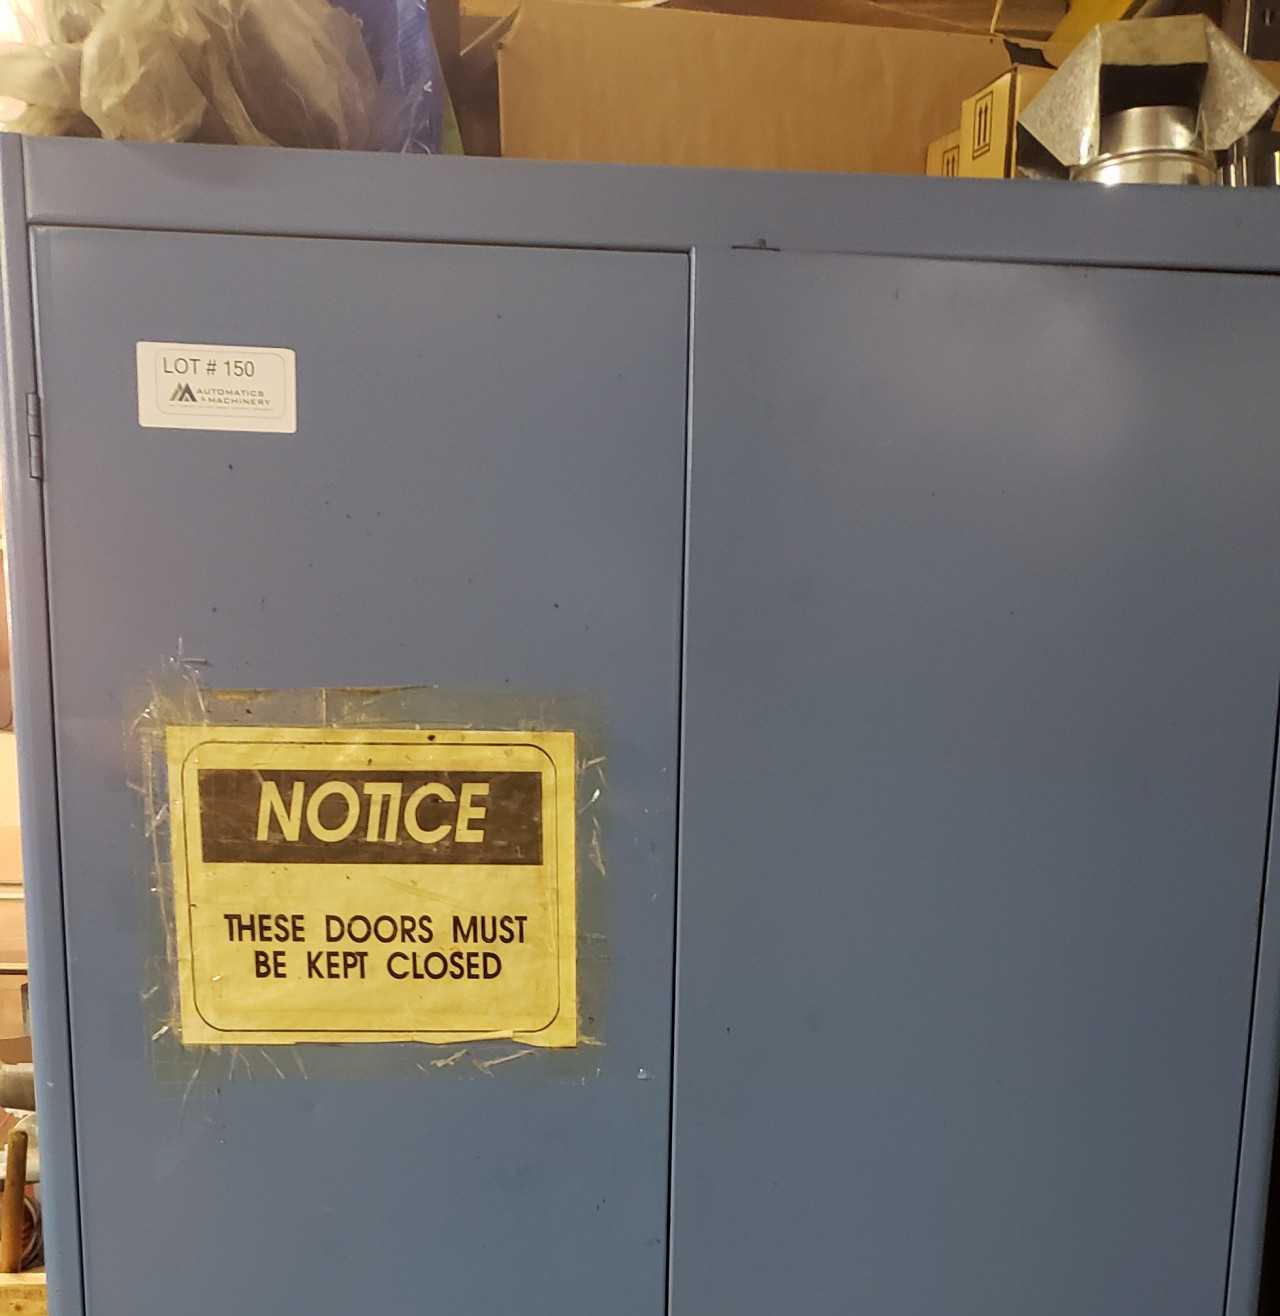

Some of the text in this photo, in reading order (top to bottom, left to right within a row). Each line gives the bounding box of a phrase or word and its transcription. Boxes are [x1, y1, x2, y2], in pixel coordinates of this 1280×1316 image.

[163, 357, 256, 377] LOT # 150
[197, 387, 265, 397] AUTOMATICS
[207, 396, 272, 406] MACHINERY
[255, 780, 491, 845] NOTICE
[223, 913, 528, 944] THESE DOORS MUST
[255, 950, 502, 980] BE KEPT CLOSED
